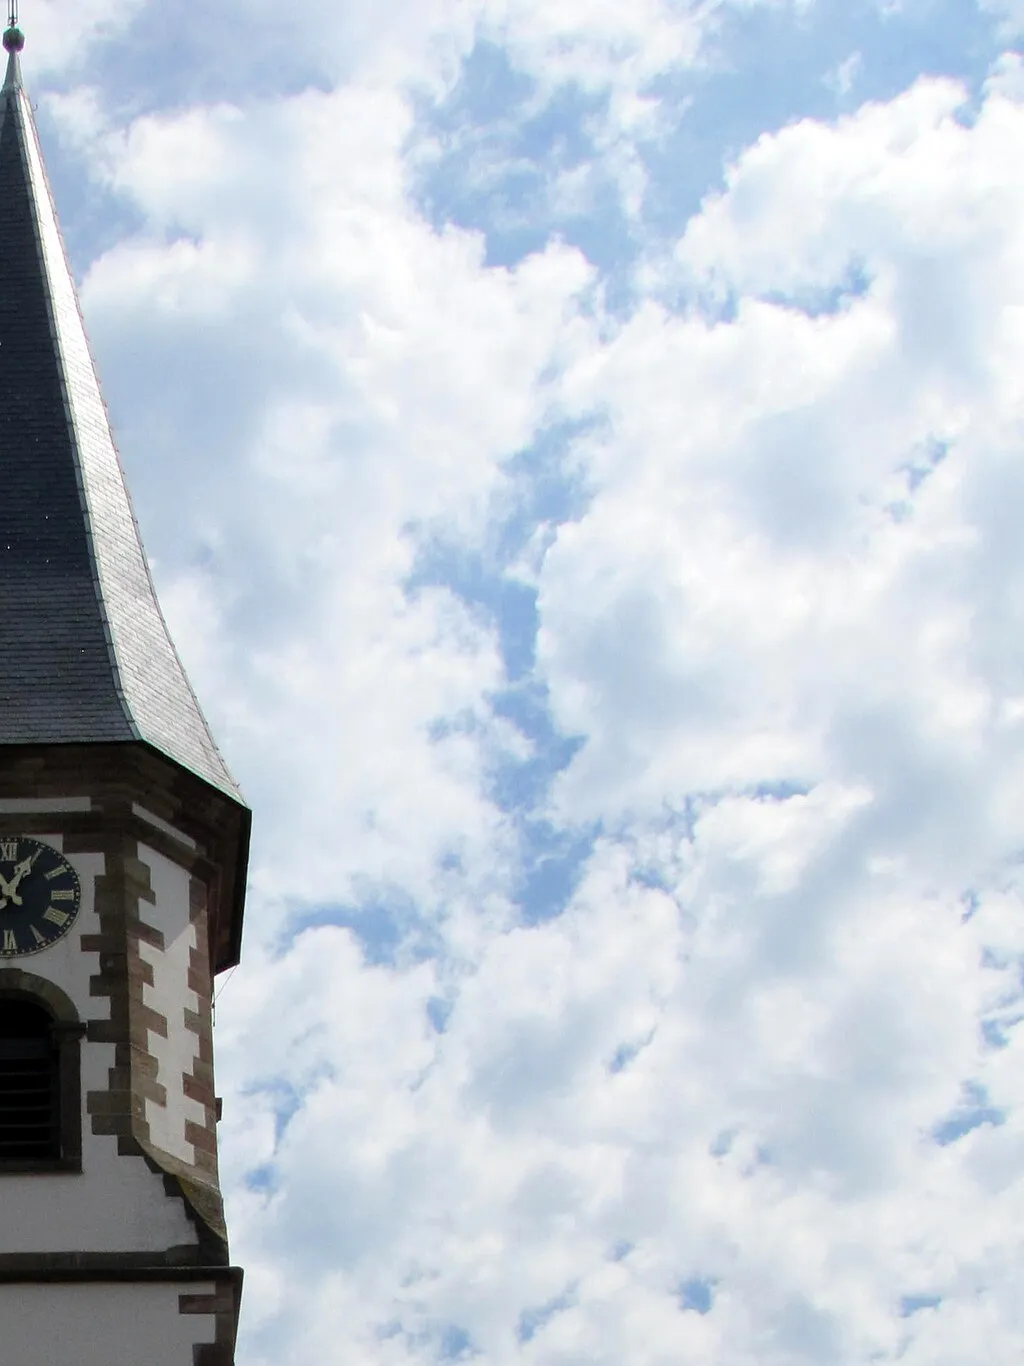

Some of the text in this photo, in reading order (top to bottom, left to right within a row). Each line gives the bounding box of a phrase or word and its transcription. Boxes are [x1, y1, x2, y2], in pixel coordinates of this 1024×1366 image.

[0, 842, 18, 862] XII
[43, 864, 68, 880] II
[50, 889, 74, 901] III
[2, 929, 18, 950] VI
[29, 924, 46, 944] V
